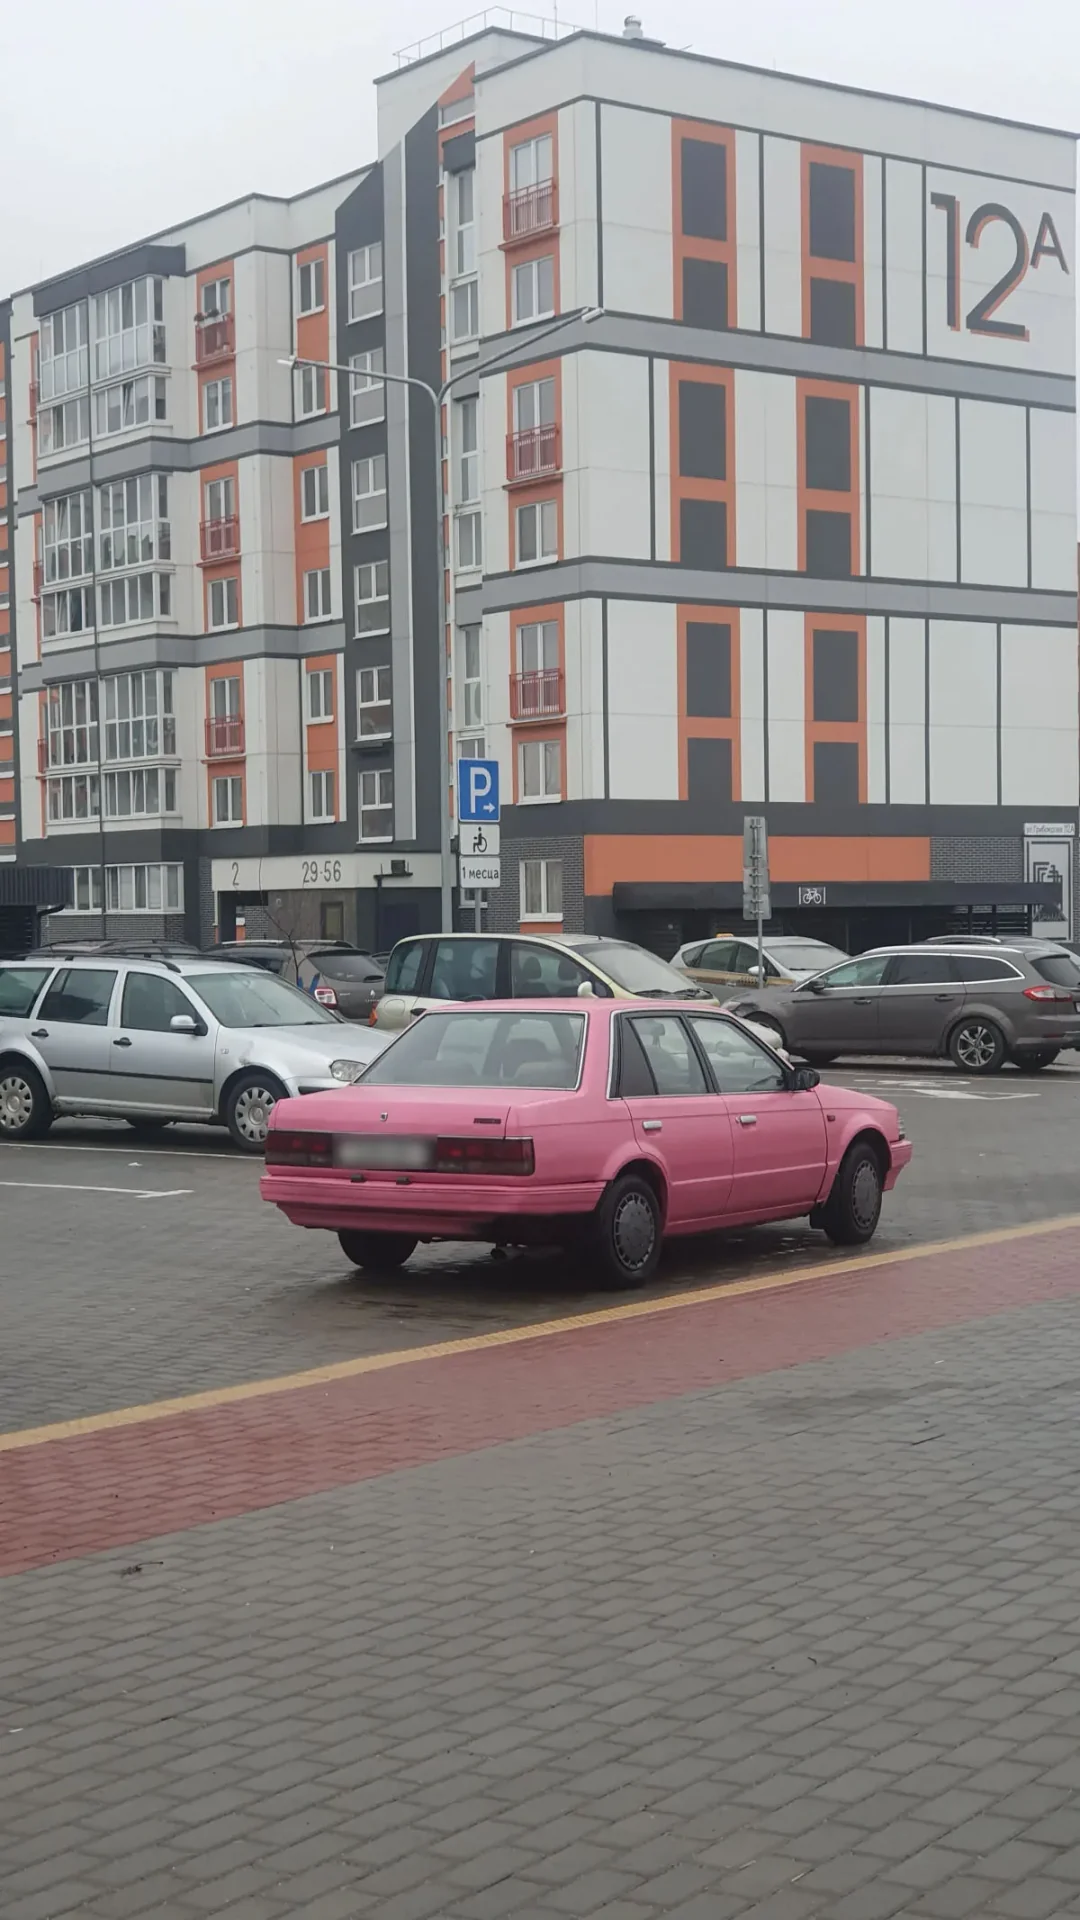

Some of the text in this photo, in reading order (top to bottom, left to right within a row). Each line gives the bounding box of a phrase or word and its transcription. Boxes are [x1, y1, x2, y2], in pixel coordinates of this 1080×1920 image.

[930, 192, 1069, 342] 12А
[469, 766, 492, 814] P
[231, 861, 240, 886] 2
[302, 860, 342, 883] 29-56
[462, 866, 499, 880] 1 месца
